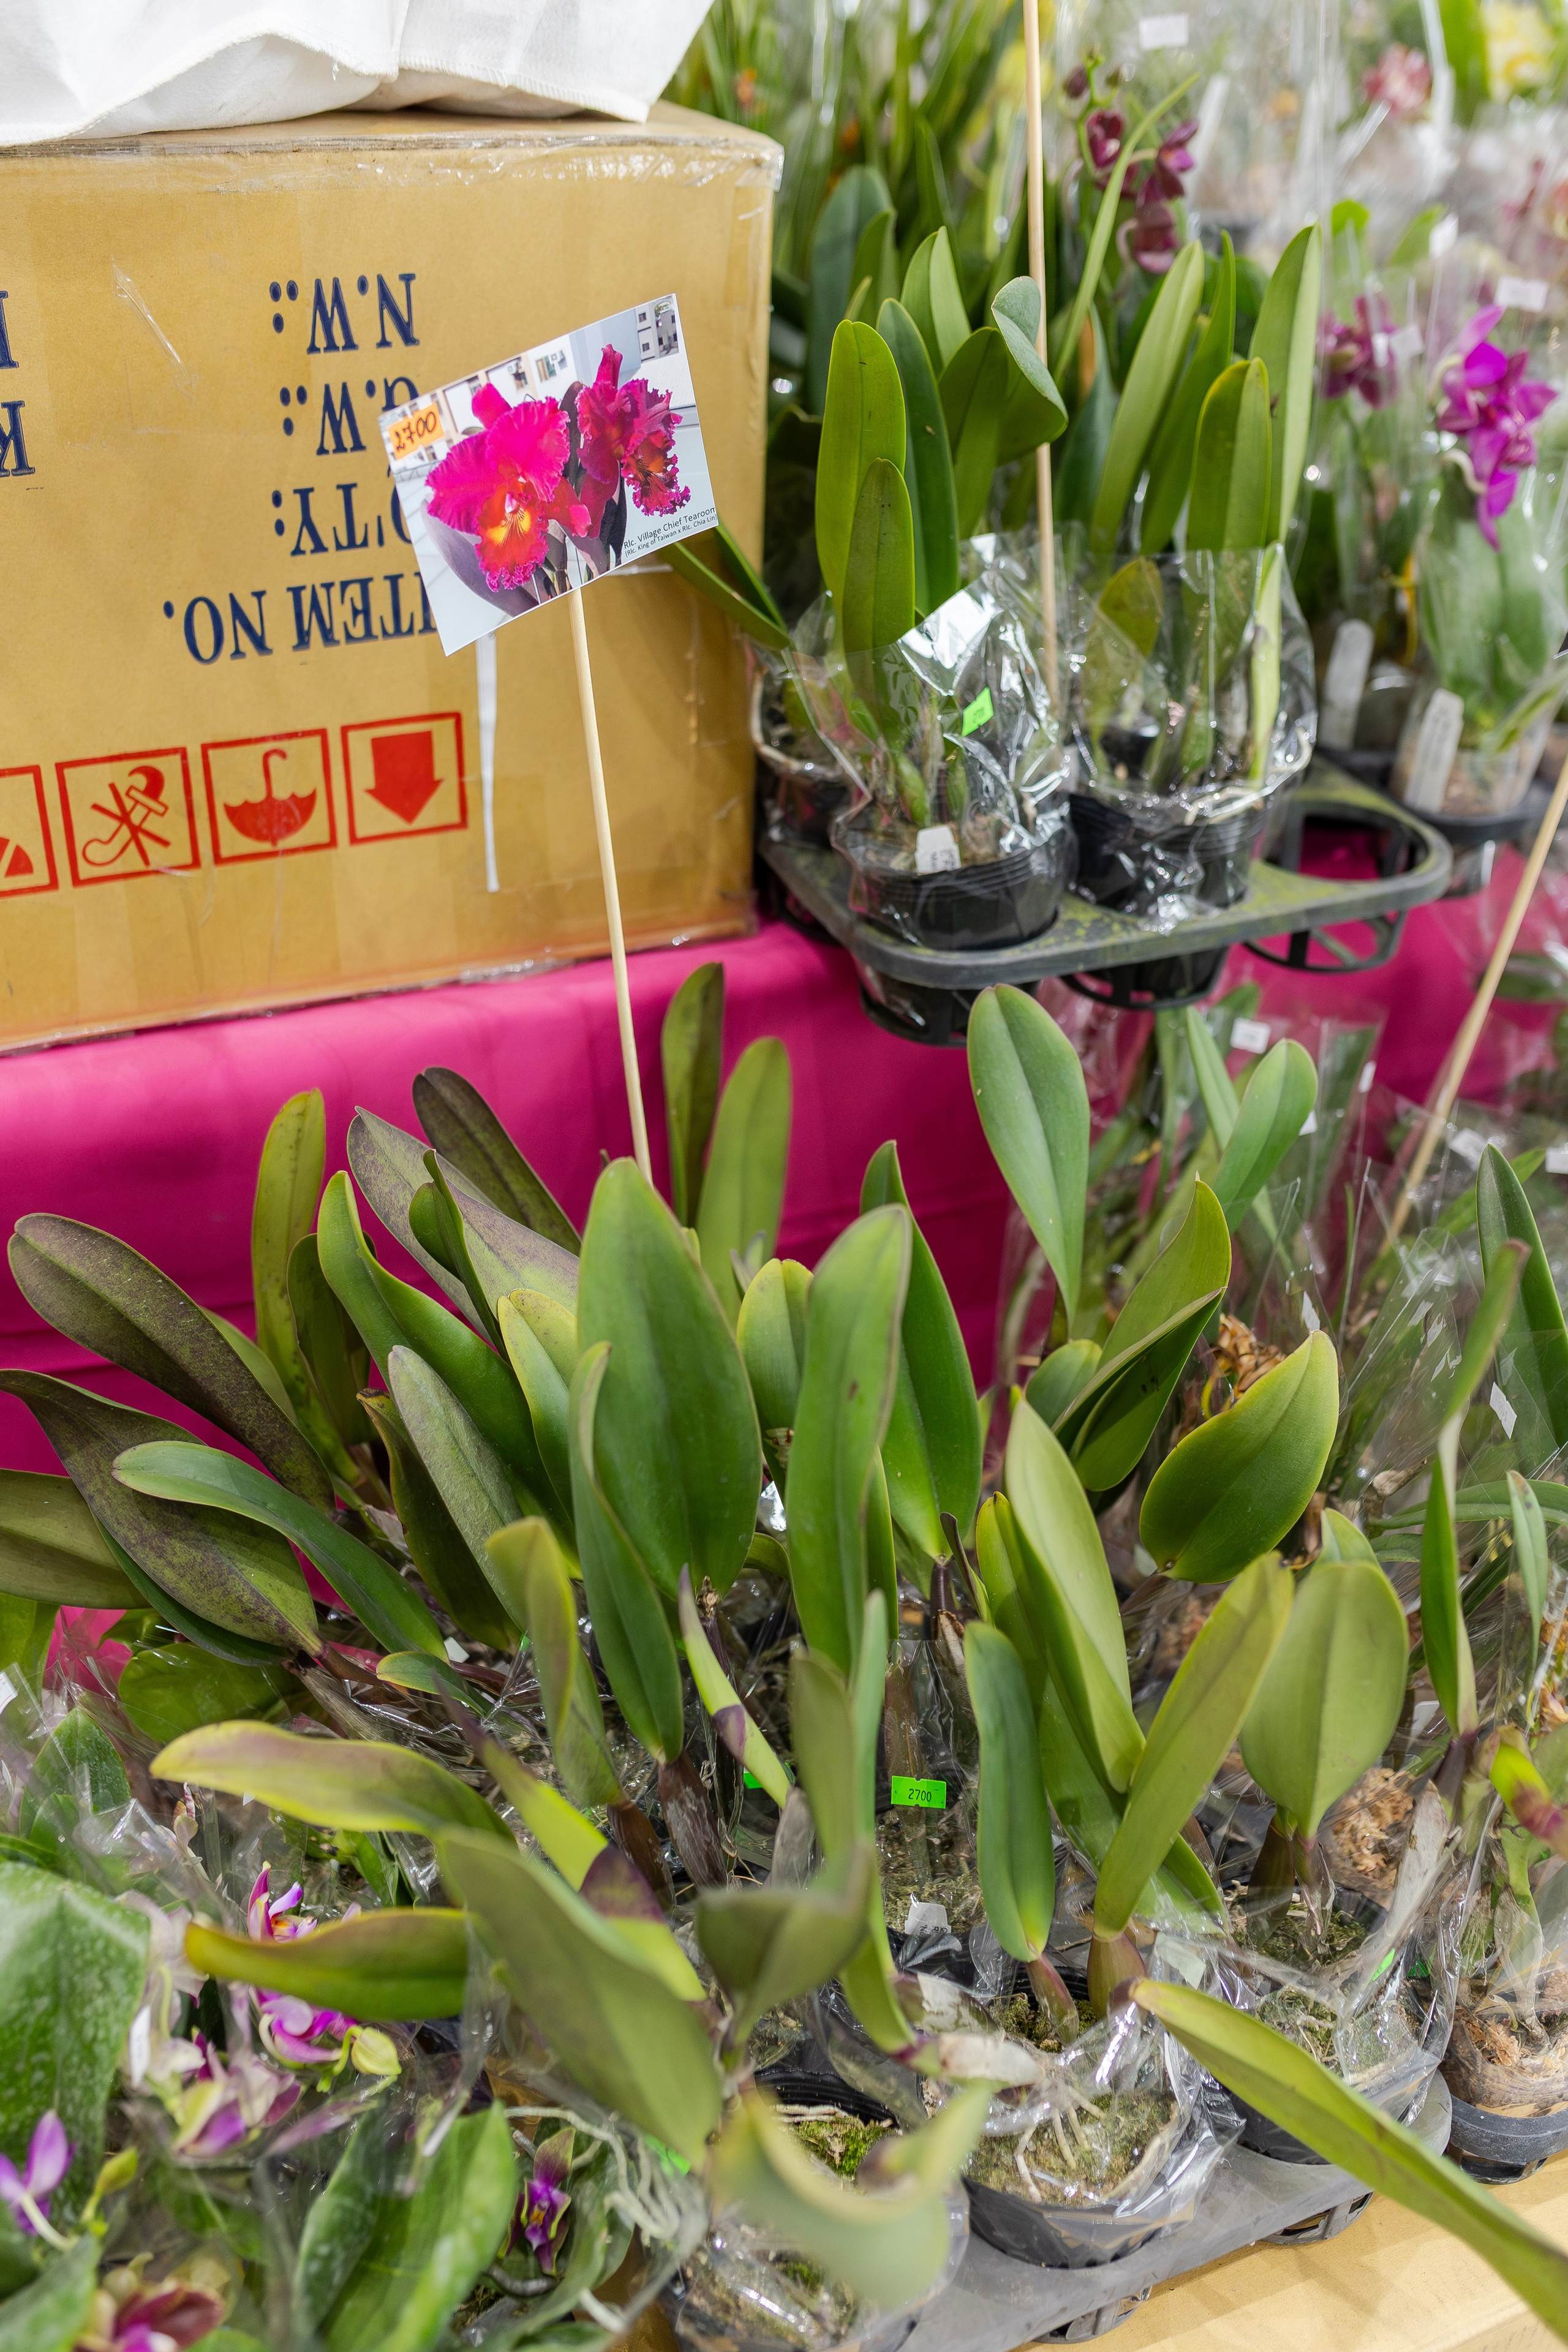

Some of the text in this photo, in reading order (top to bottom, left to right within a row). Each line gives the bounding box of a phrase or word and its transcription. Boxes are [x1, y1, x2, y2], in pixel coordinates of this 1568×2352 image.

[394, 412, 436, 450] 2700
[624, 540, 636, 549] Rlc.
[637, 528, 662, 542] Village
[663, 518, 682, 532] Chief
[638, 541, 650, 551] King
[657, 530, 677, 542] Taiwan
[693, 518, 706, 527] Chia
[163, 571, 437, 666] ITEM NO.
[908, 1788, 932, 1802] 2700
